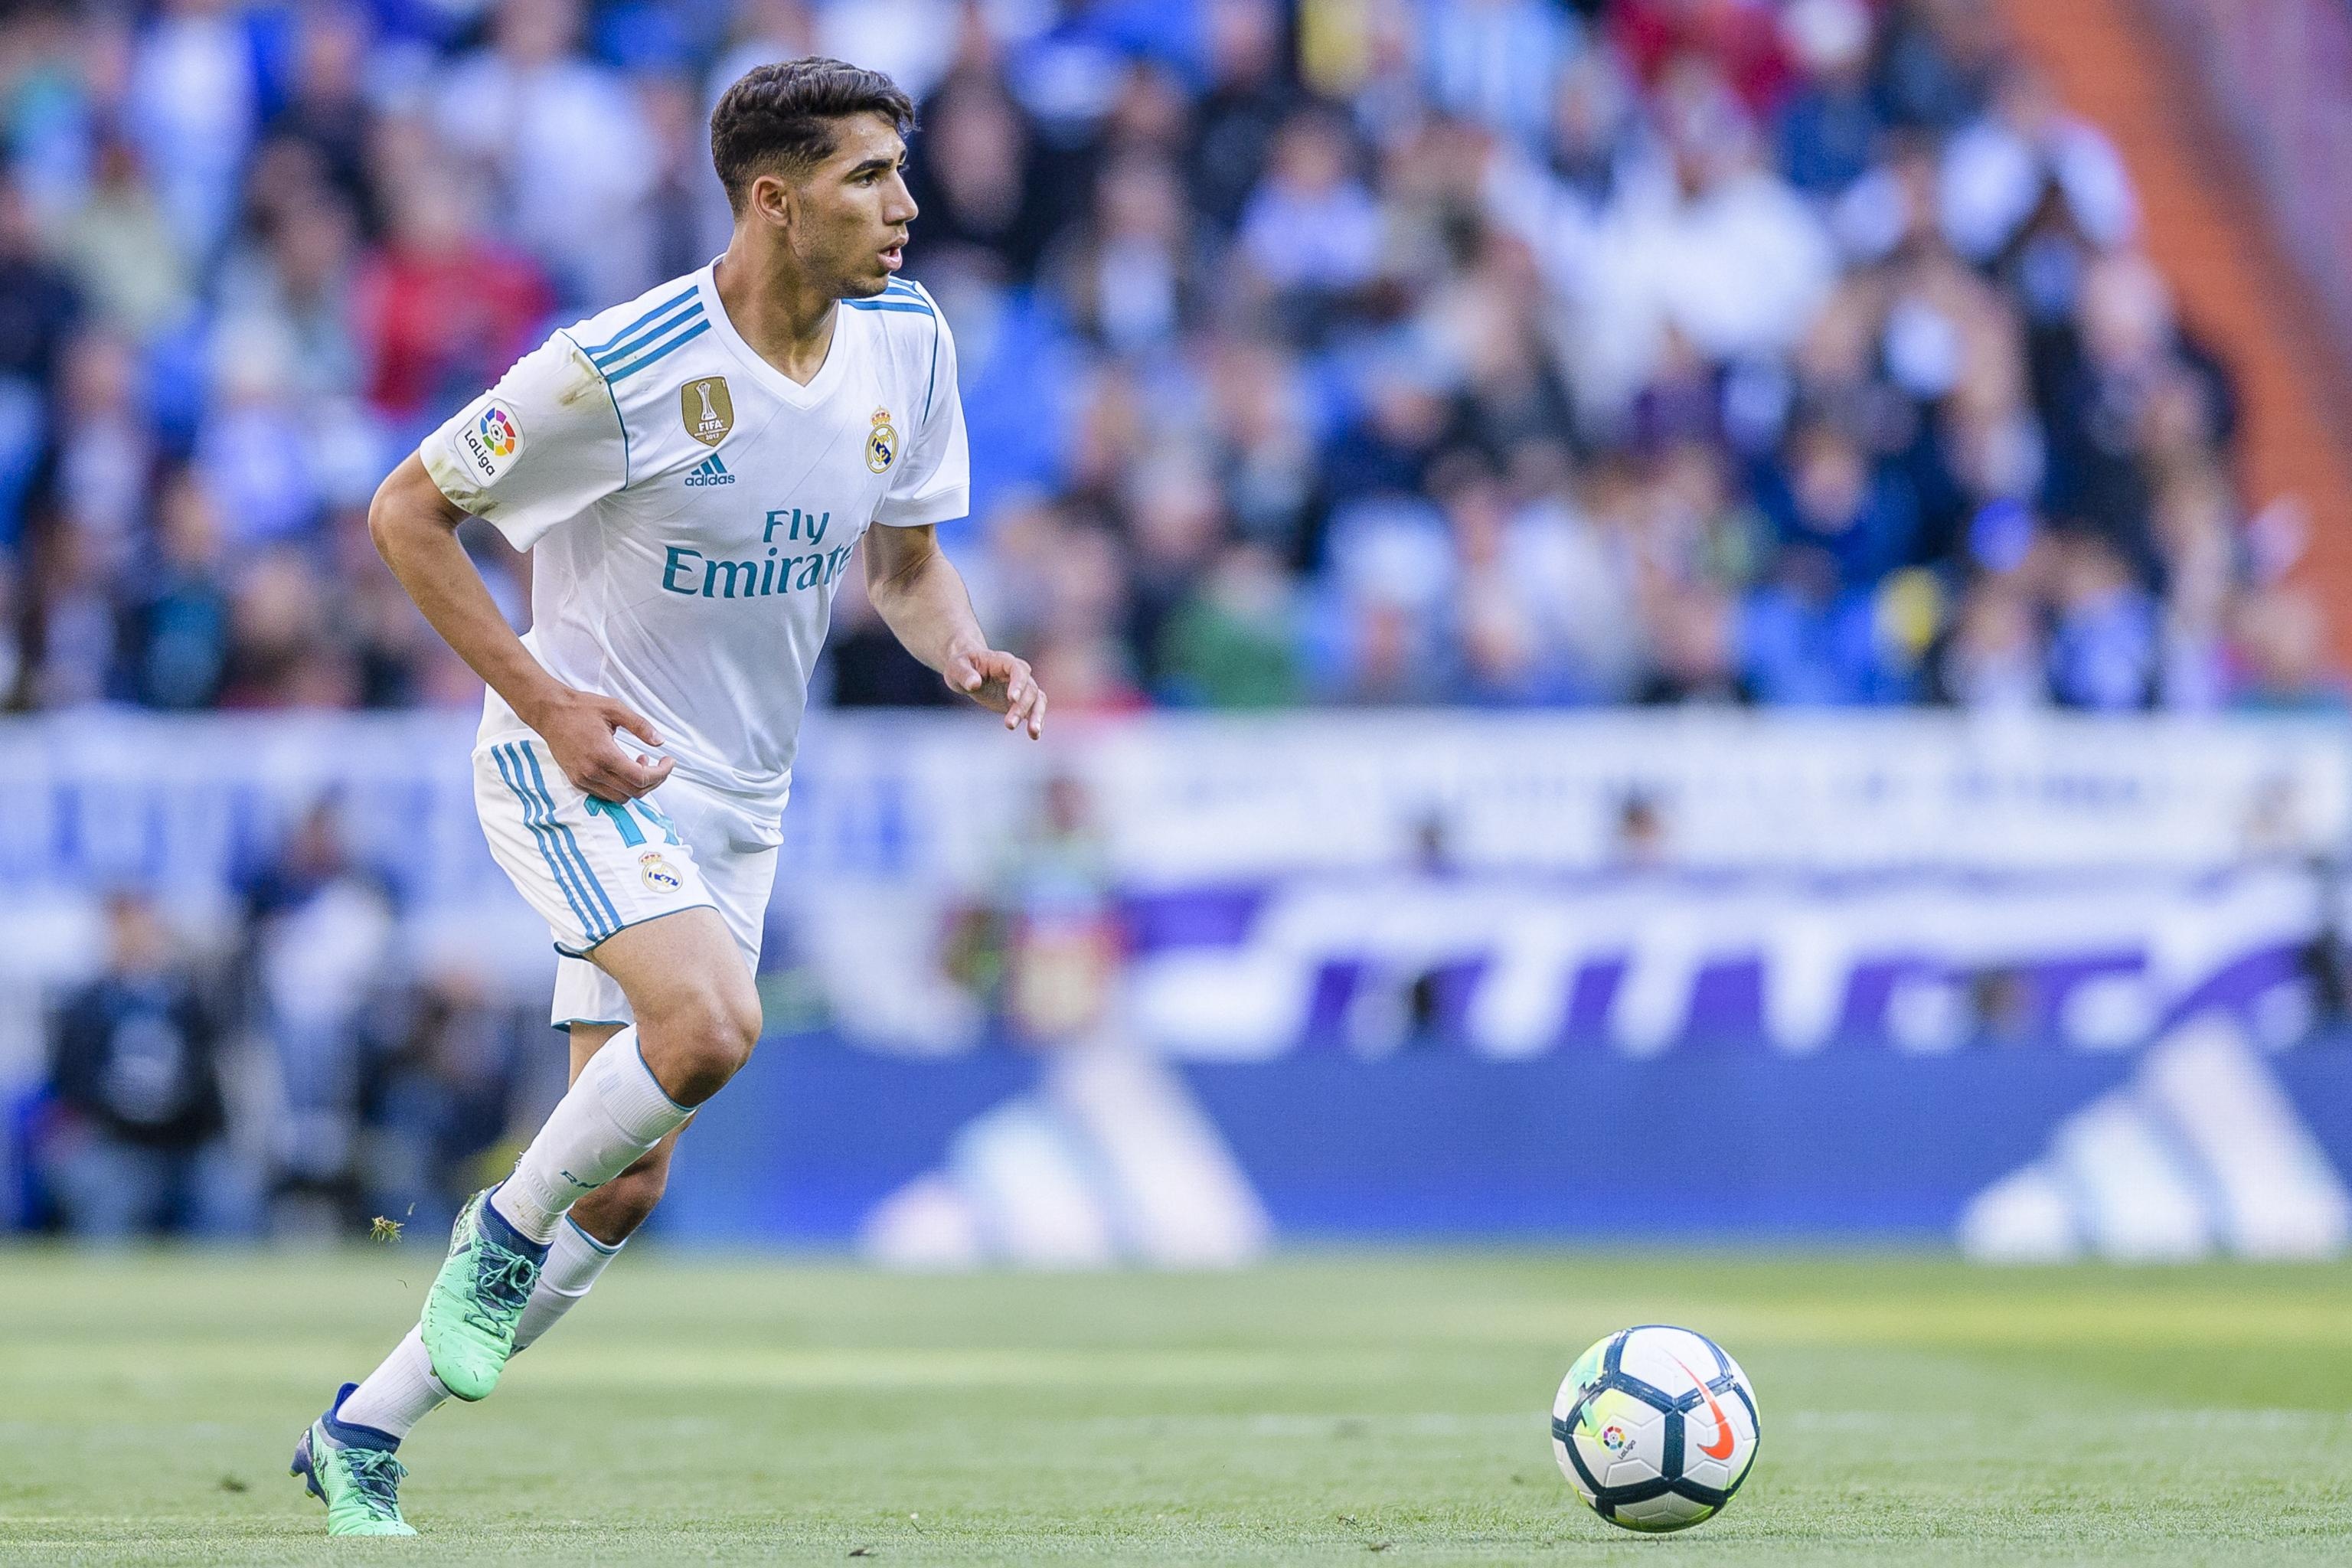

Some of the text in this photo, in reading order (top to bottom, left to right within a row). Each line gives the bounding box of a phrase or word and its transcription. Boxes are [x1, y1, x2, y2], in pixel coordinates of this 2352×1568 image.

[698, 419, 723, 432] FIFA
[705, 433, 720, 441] 2017
[464, 429, 496, 477] LaLiga
[684, 473, 736, 487] adidas
[763, 508, 830, 546] Fly
[662, 530, 866, 599] Emirate
[1617, 1439, 1636, 1460] LaLiga
